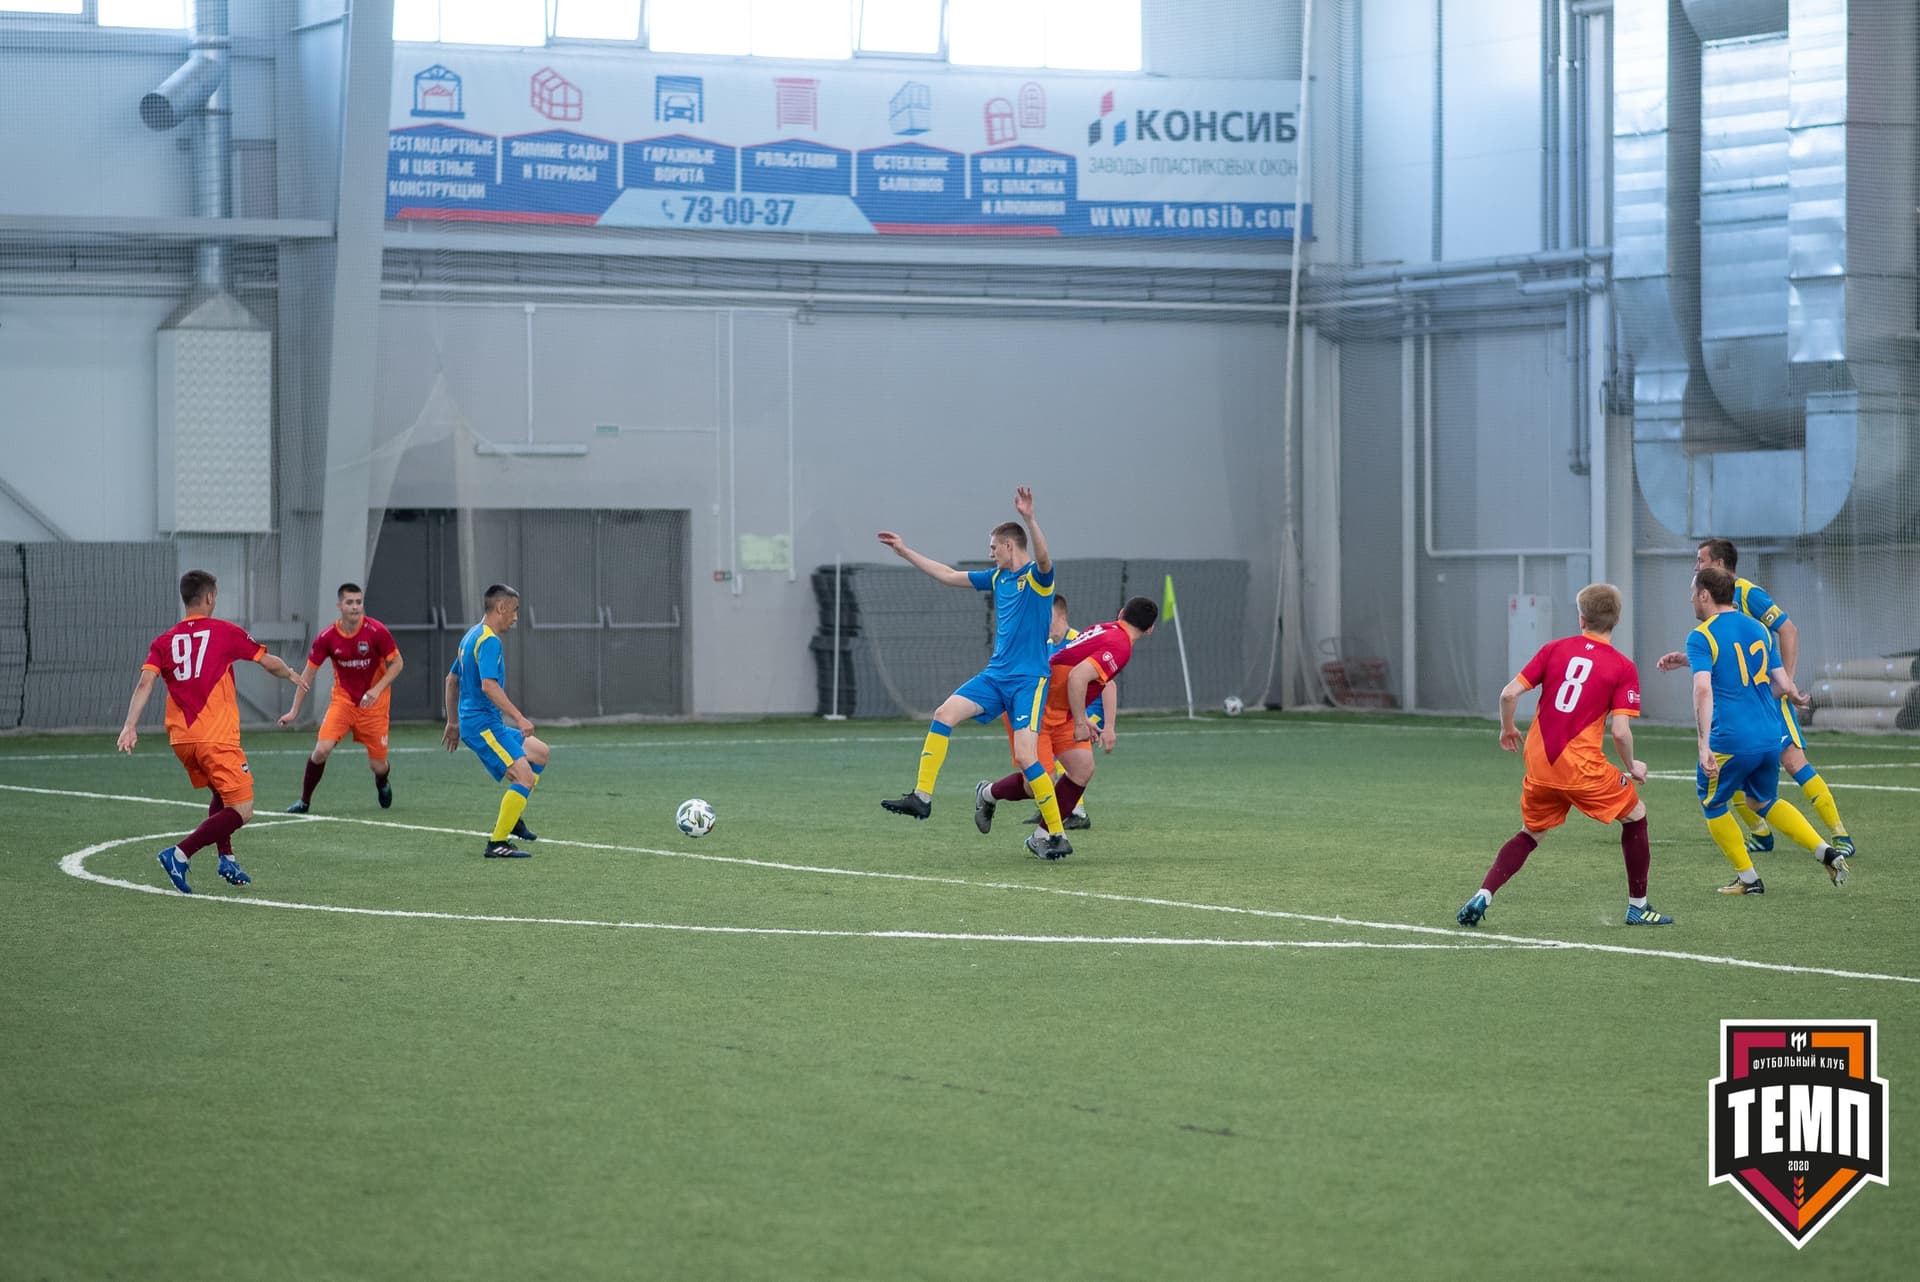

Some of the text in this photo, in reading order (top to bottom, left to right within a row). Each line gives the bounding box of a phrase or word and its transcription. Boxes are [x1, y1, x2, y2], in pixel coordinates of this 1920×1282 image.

[1136, 109, 1297, 143] КОНСИБ
[567, 143, 609, 162] САДЫ
[643, 147, 716, 165] ГАРАЖНЫЕ
[399, 158, 476, 177] И ЦВЕТНЫЕ
[522, 163, 597, 182] И ТЕРРАСЫ
[873, 155, 949, 172] ОСТЕКЛЕНИЕ
[979, 157, 1067, 175] ОКНА И ДВЕРИ
[1088, 156, 1298, 176] ЗАВОДЫ ПЛАСТИКОВЫХ ОКОН
[654, 167, 705, 183] ВОРОТА
[878, 176, 944, 192] БАЛКОНОВ
[389, 180, 486, 200] КОНСТРУКЦИИ
[982, 178, 1066, 195] ИЗ ПЛАСТИКА
[681, 196, 796, 226] 73-00-37
[981, 200, 992, 215] И
[171, 629, 211, 682] 97
[1733, 639, 1771, 687] 12
[1554, 656, 1594, 713] 8
